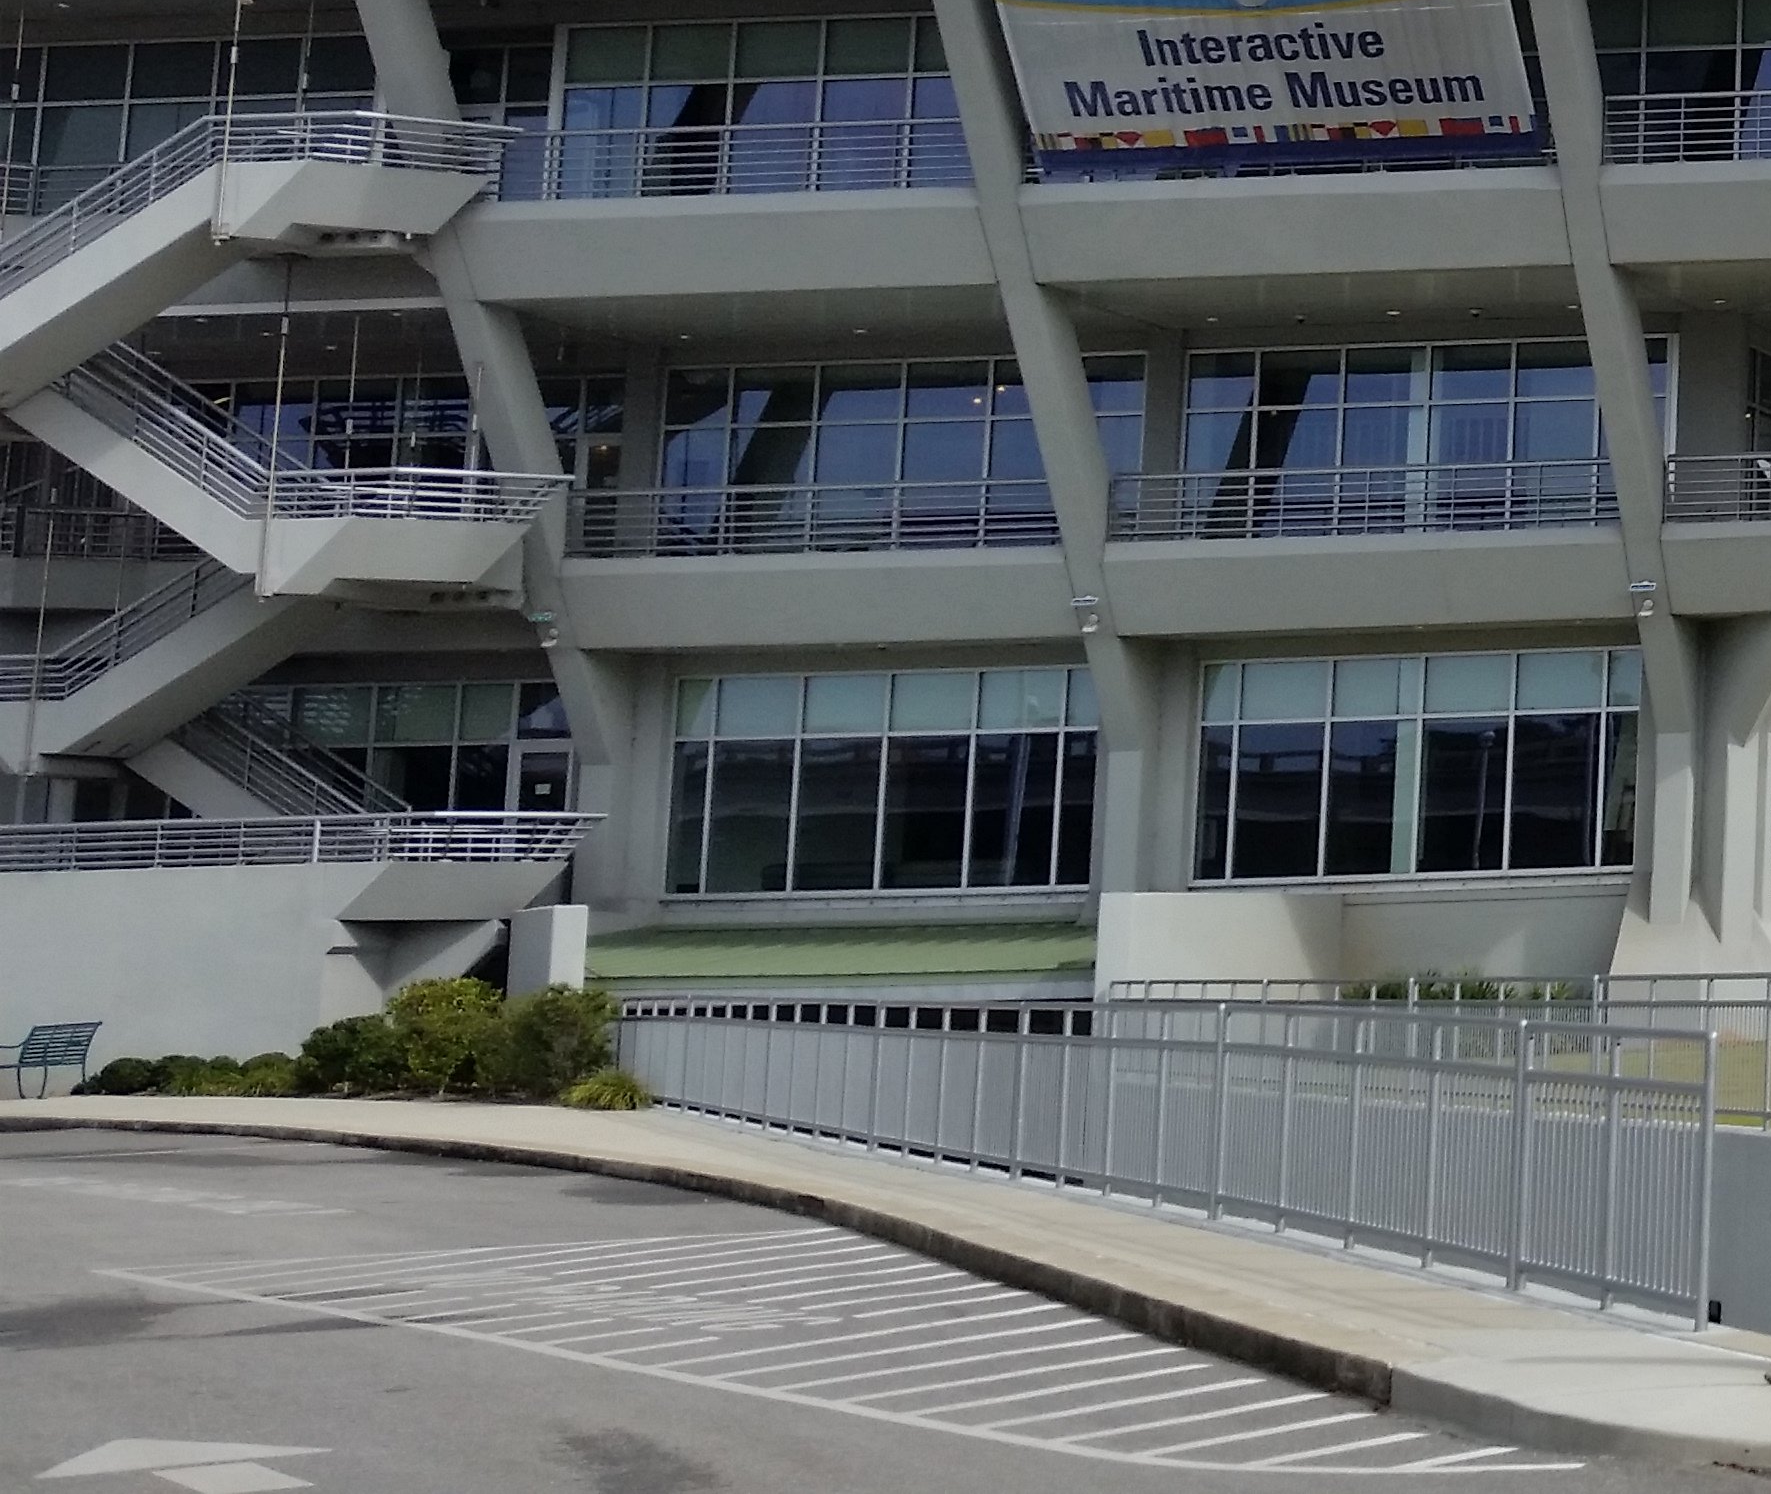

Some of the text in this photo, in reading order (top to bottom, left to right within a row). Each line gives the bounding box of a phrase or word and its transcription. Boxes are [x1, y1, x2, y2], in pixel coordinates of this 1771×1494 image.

[1138, 21, 1385, 68] Interactive
[1064, 70, 1485, 118] Maritime Museum
